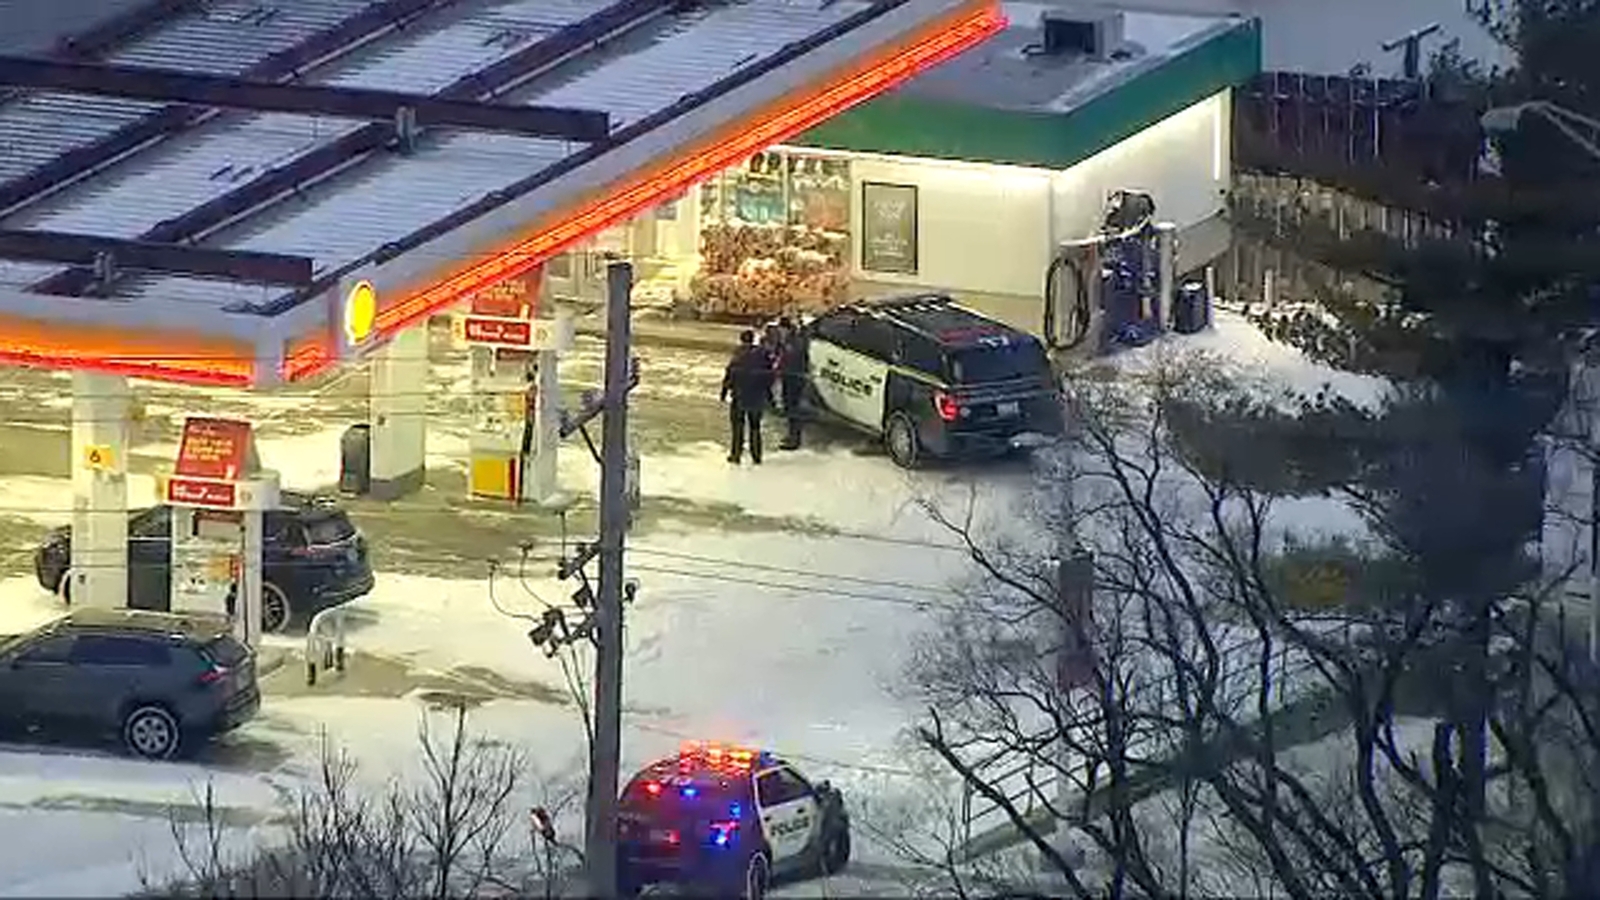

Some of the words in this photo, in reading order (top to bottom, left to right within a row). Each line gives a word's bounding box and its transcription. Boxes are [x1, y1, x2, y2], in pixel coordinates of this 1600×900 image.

[820, 367, 873, 396] POLICE
[90, 449, 101, 463] 6
[771, 816, 810, 837] POLICE
